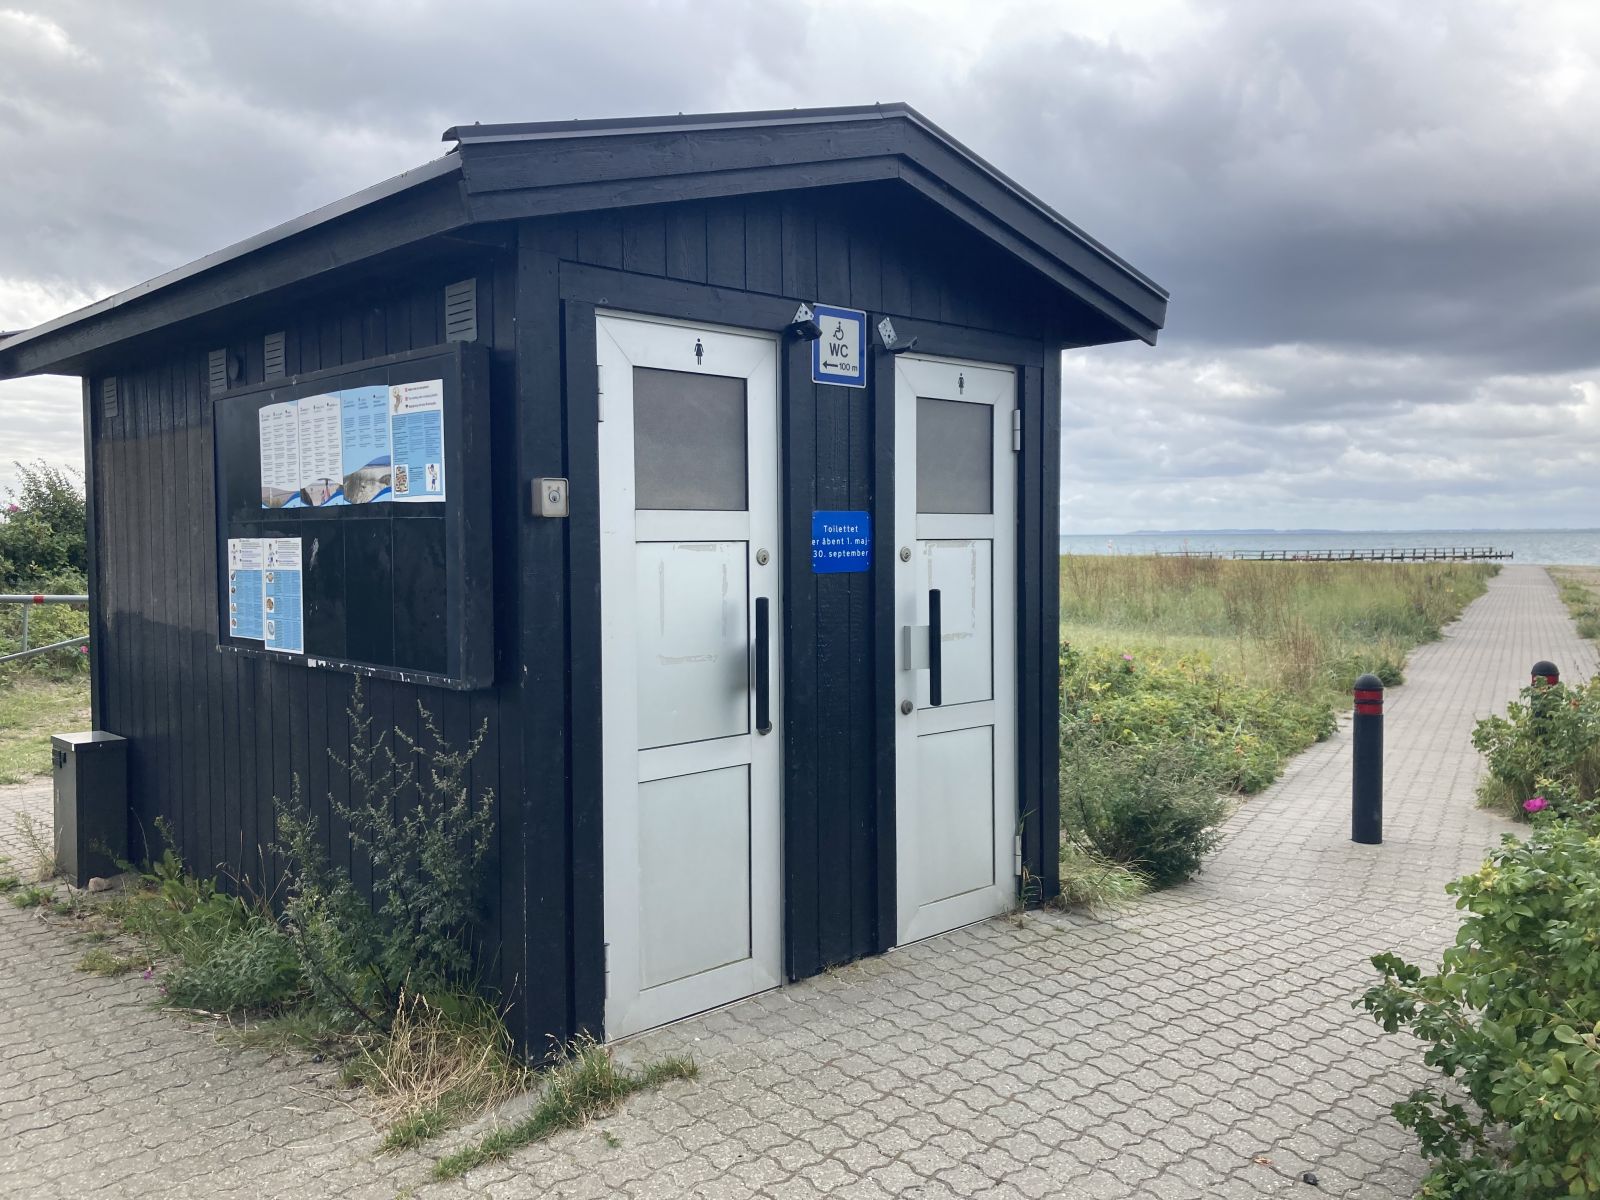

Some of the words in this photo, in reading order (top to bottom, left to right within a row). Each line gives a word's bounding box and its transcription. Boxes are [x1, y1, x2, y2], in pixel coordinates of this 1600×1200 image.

[829, 342, 849, 358] WC
[839, 362, 851, 371] 100
[823, 524, 859, 533] Toilettet
[822, 537, 845, 546] åbent
[846, 537, 853, 545] 1.
[812, 549, 827, 558] 30.
[828, 549, 869, 559] september
